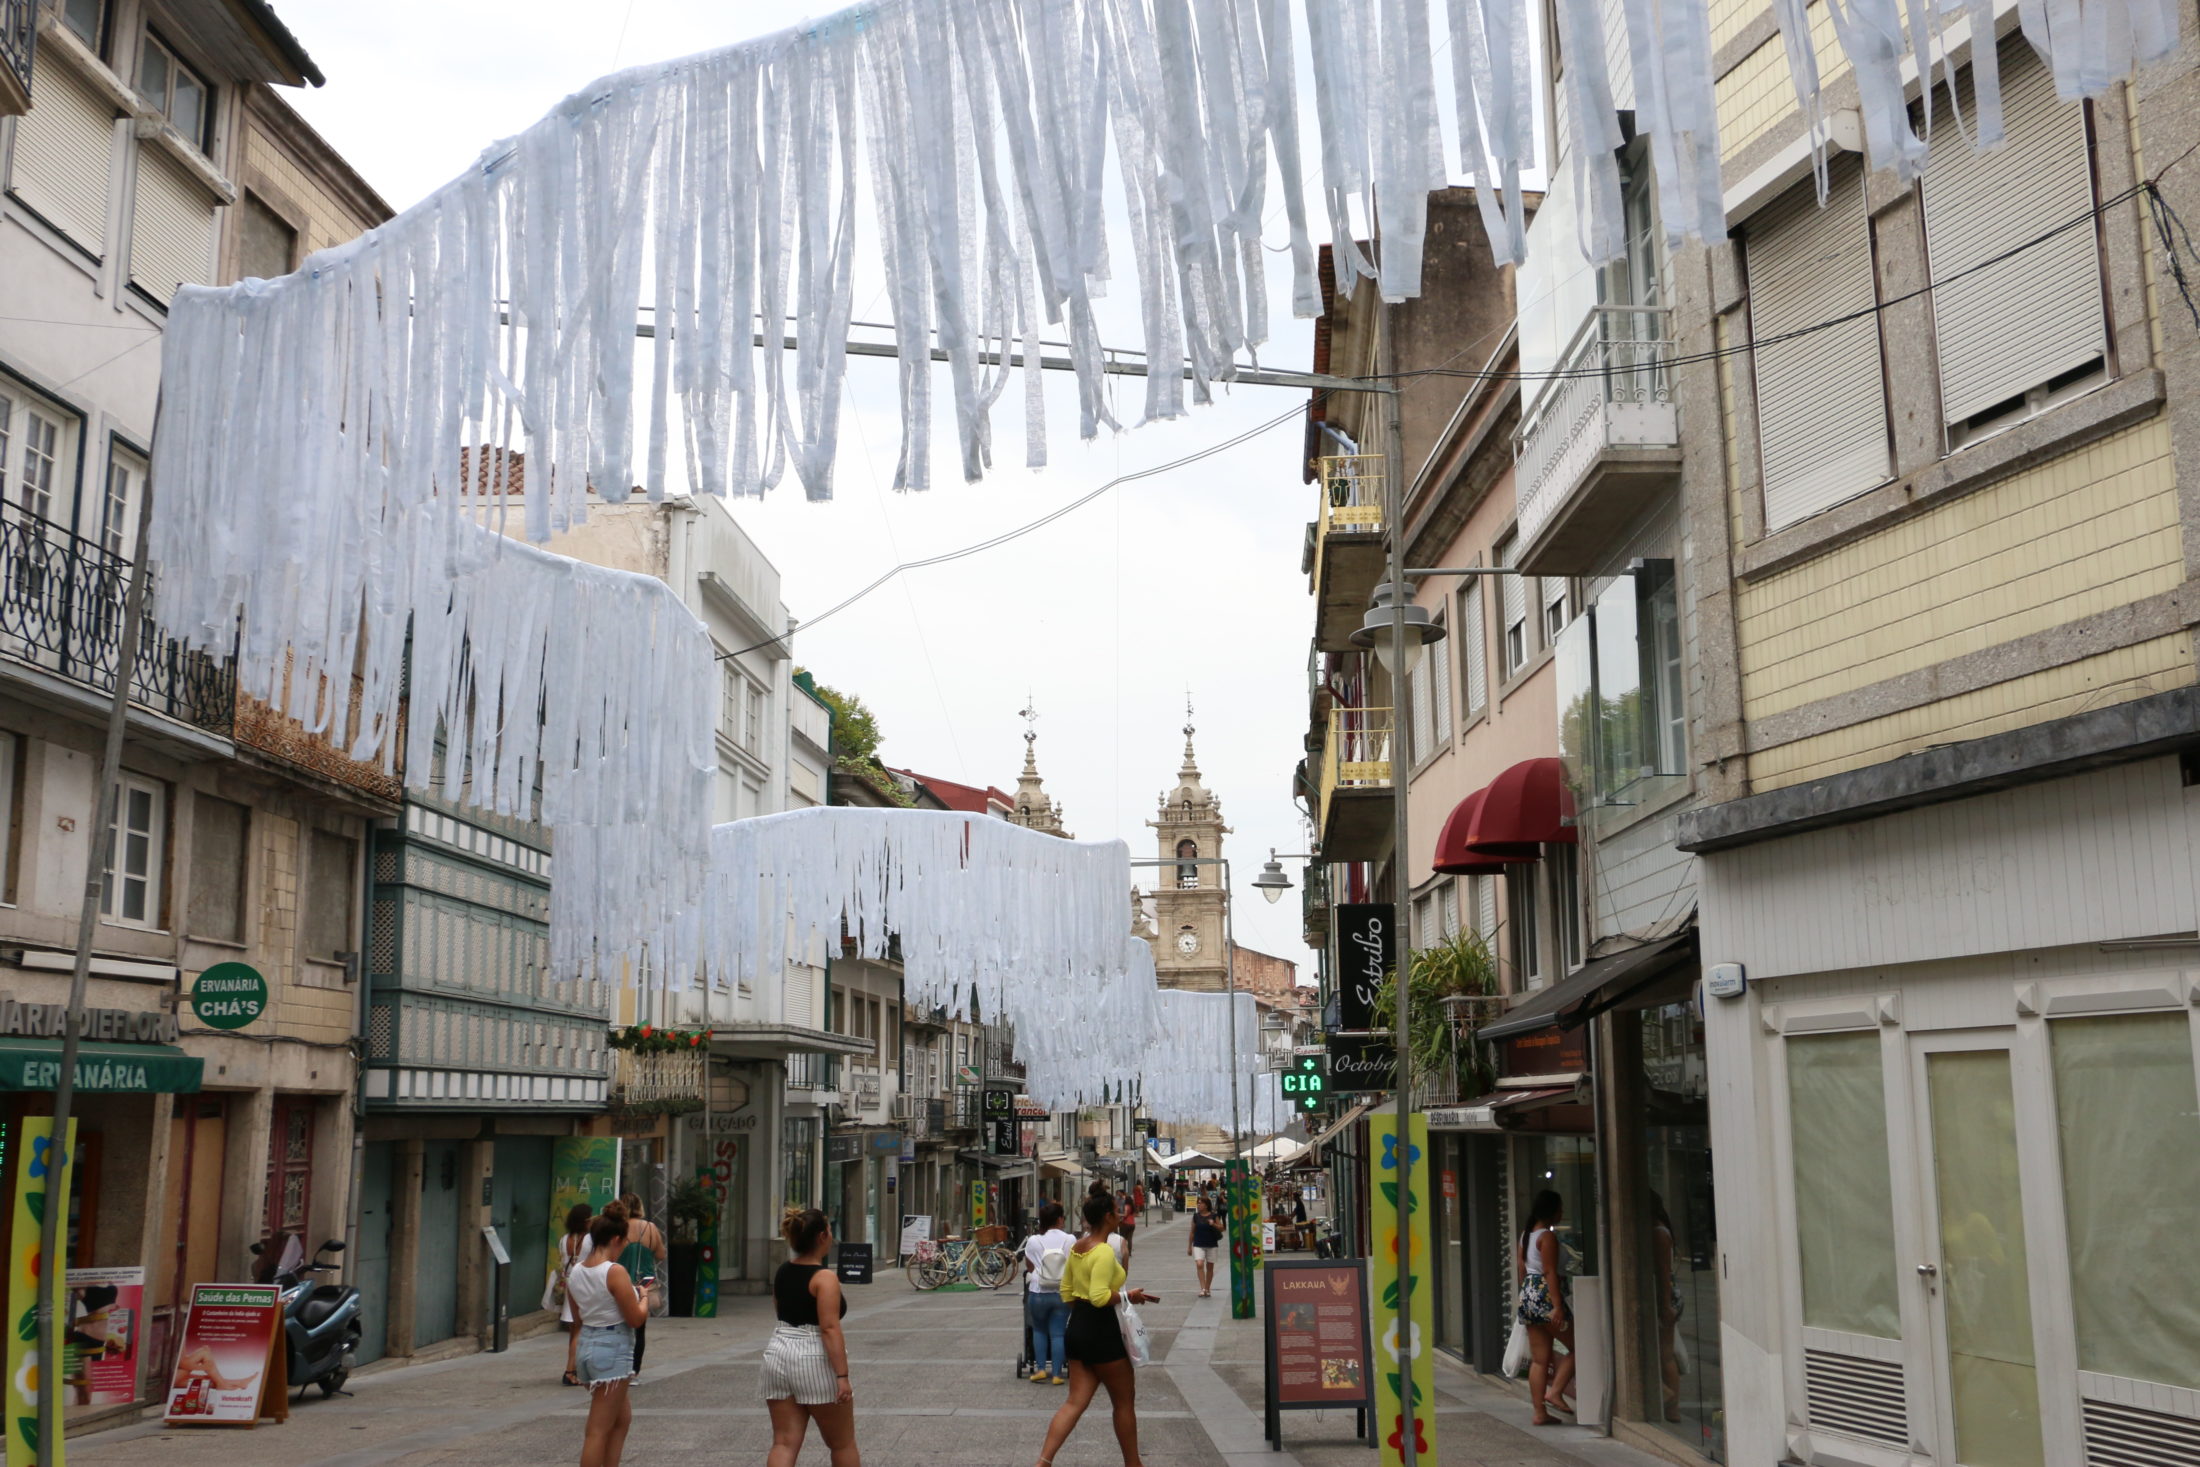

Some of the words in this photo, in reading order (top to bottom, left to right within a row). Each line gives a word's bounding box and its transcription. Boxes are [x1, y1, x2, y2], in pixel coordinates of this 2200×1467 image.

[1352, 917, 1383, 1010] Estribo
[200, 976, 259, 992] ERVANÁRIA
[200, 998, 259, 1016] CHÁ'S
[1284, 1075, 1321, 1092] CIA
[225, 1293, 241, 1304] das
[241, 1293, 273, 1304] Pernas
